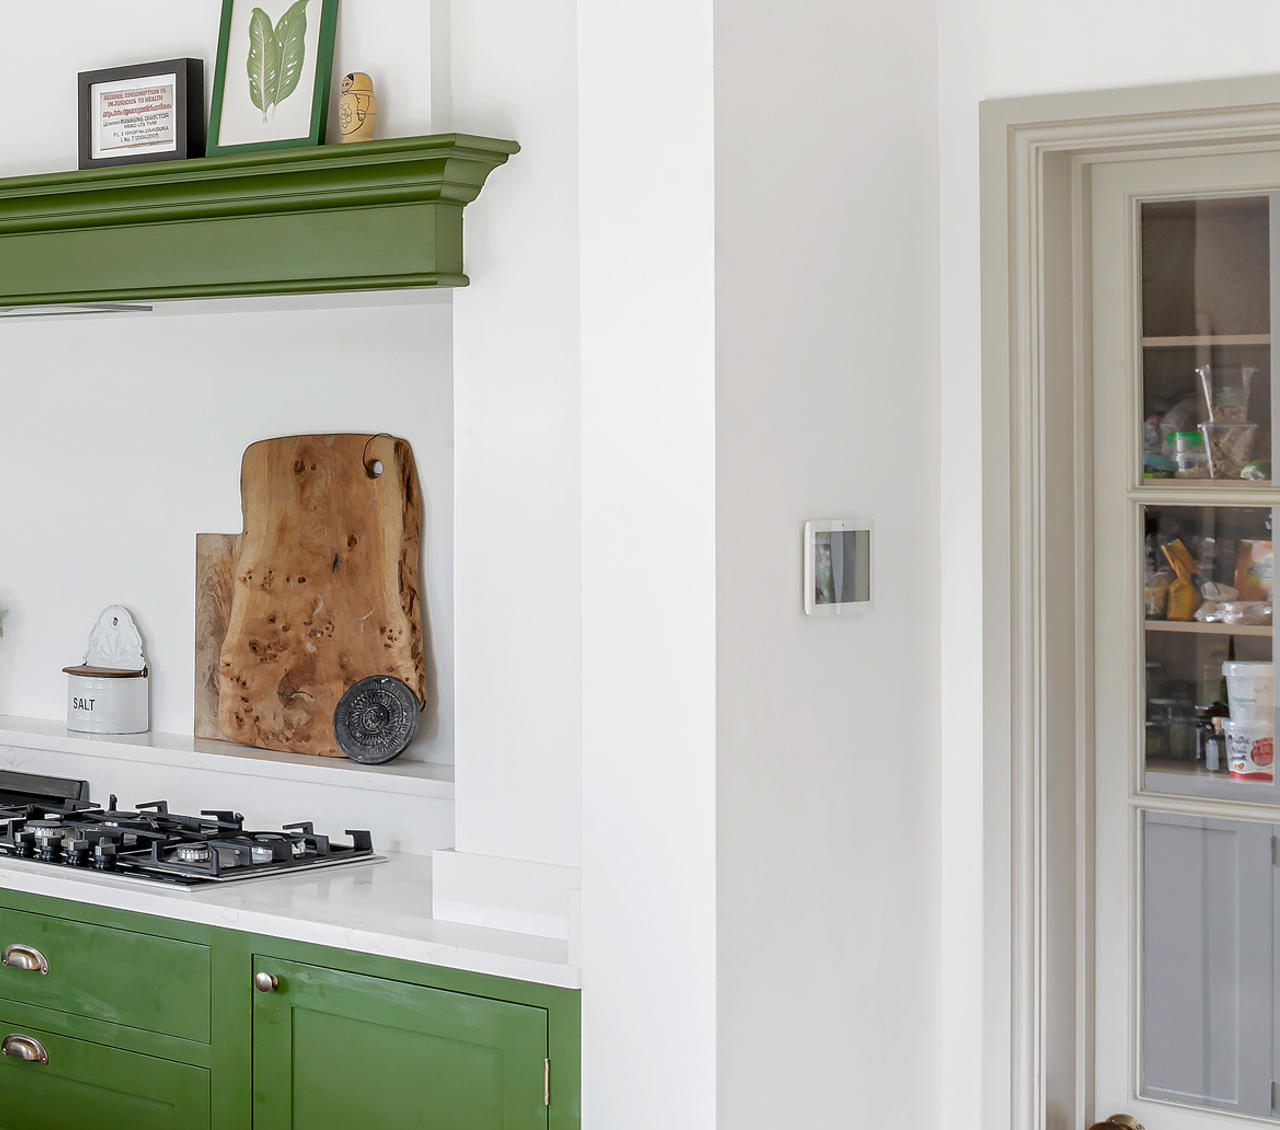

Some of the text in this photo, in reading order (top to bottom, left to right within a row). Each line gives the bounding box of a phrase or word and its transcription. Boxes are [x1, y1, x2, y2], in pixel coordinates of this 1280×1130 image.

[124, 90, 159, 98] CONSUMPTION
[145, 113, 169, 121] DIRECTOR
[73, 697, 95, 711] SALT
